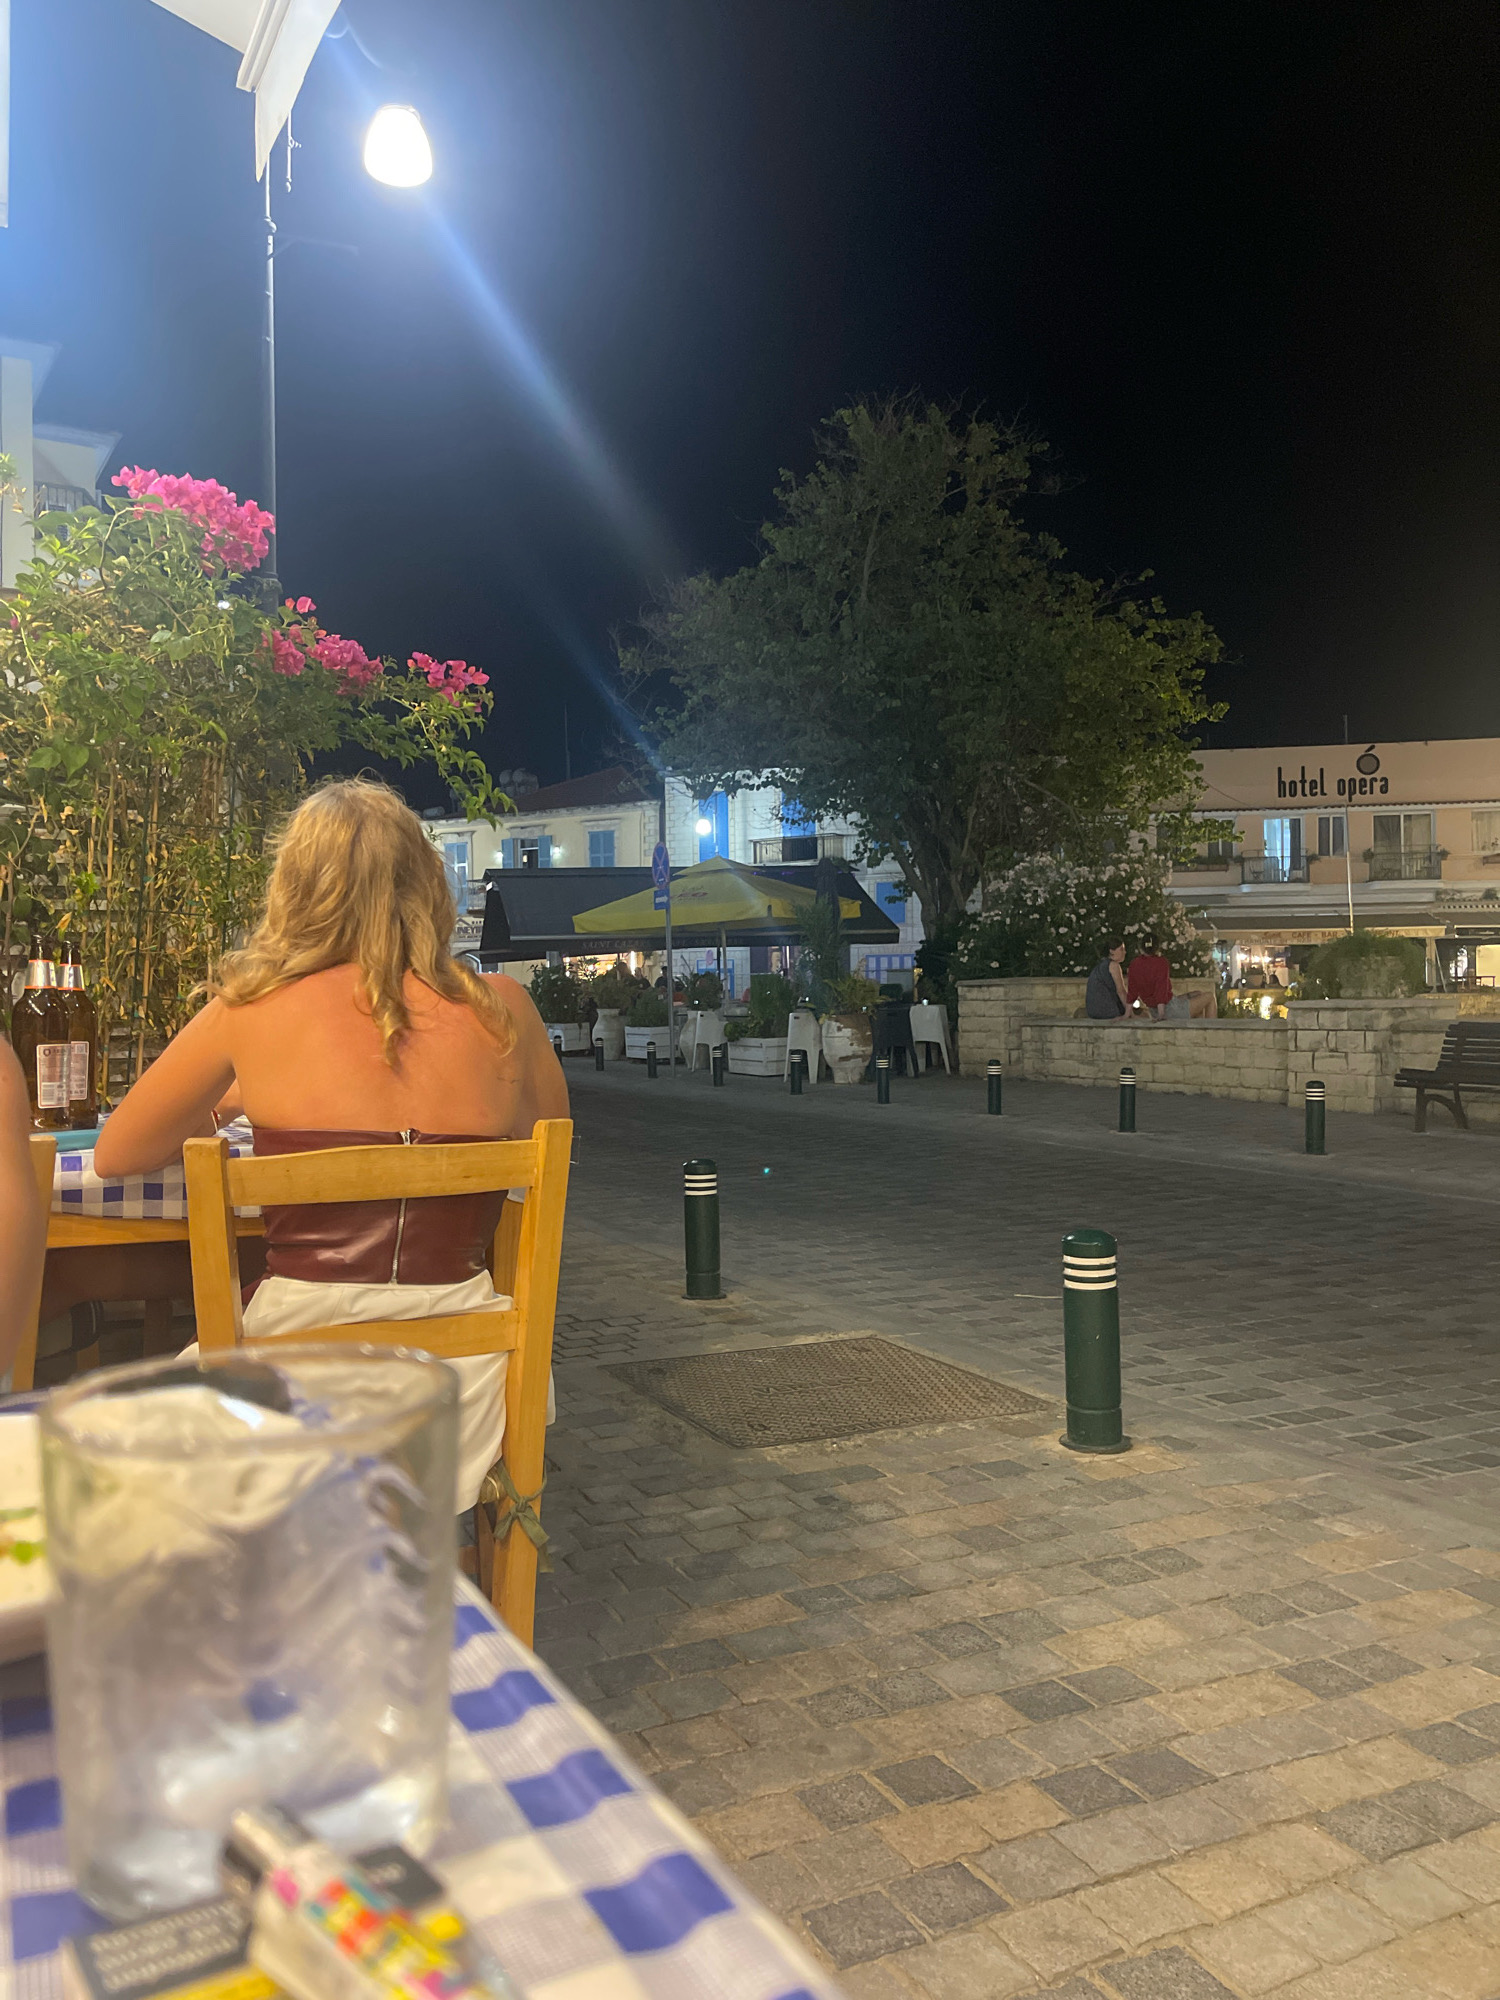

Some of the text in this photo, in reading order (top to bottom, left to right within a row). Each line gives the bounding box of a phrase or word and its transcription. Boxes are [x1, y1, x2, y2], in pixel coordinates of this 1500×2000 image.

[1277, 765, 1389, 803] hotel opera
[1321, 930, 1338, 939] BAR
